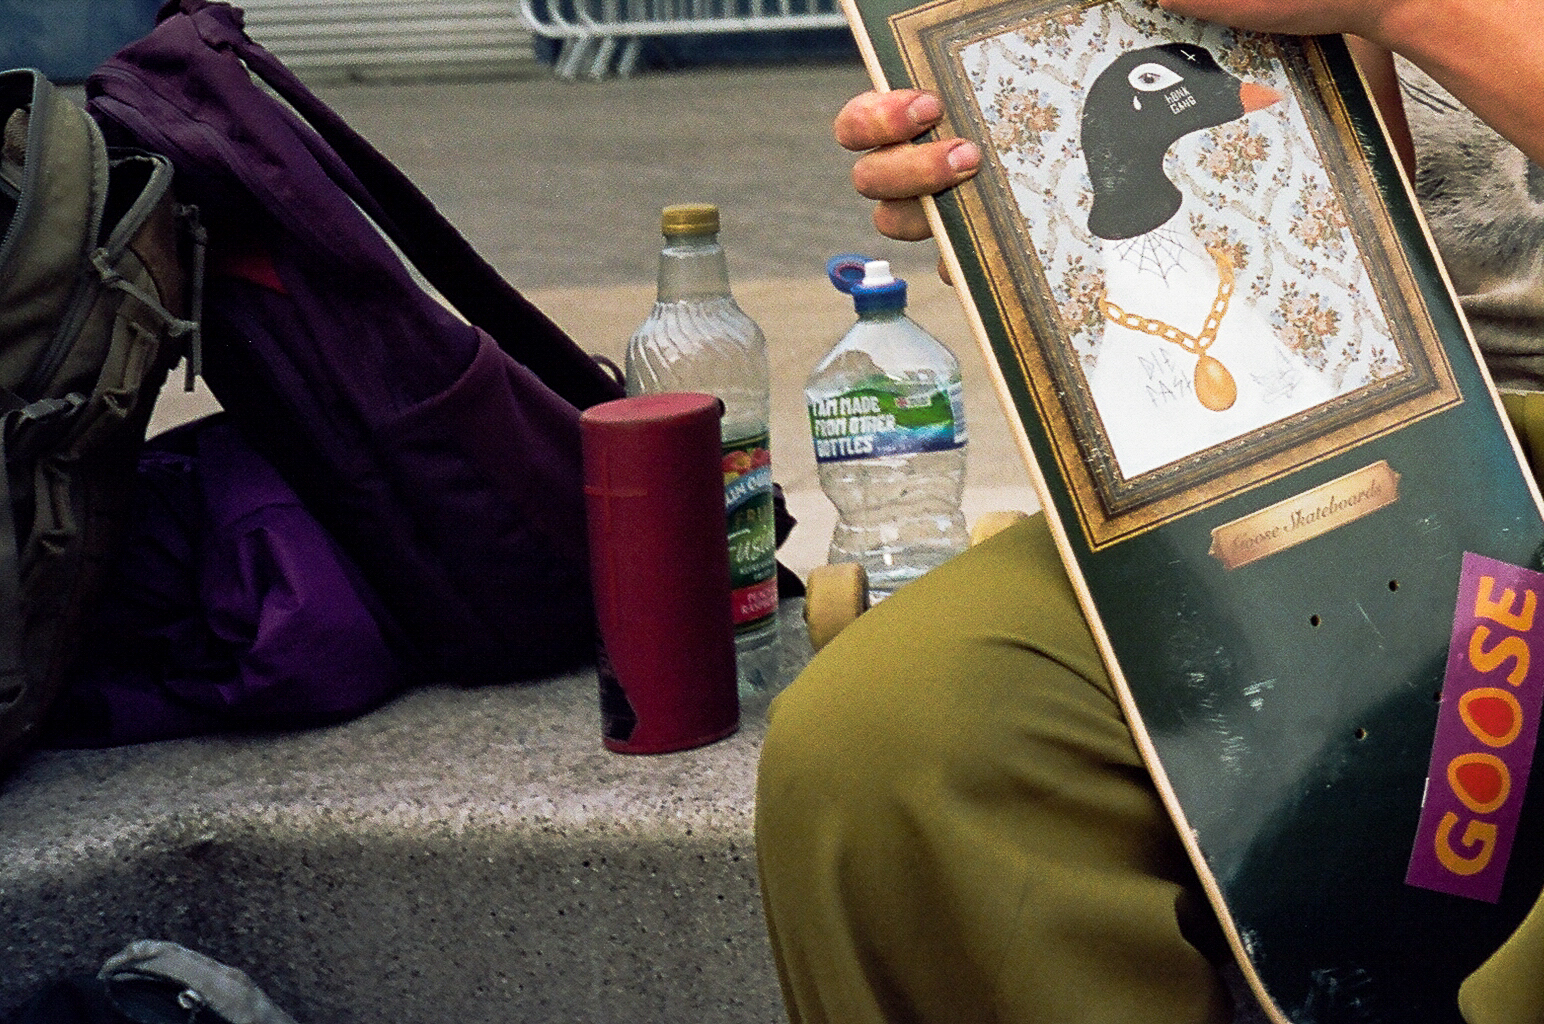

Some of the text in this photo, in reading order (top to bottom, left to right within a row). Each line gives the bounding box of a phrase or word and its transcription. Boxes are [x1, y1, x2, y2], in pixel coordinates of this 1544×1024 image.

[1169, 95, 1197, 116] GANG
[840, 396, 881, 415] MADE
[816, 434, 874, 458] BOTTLES
[1283, 479, 1383, 534] Skateboards
[1434, 575, 1537, 876] GOOSE
